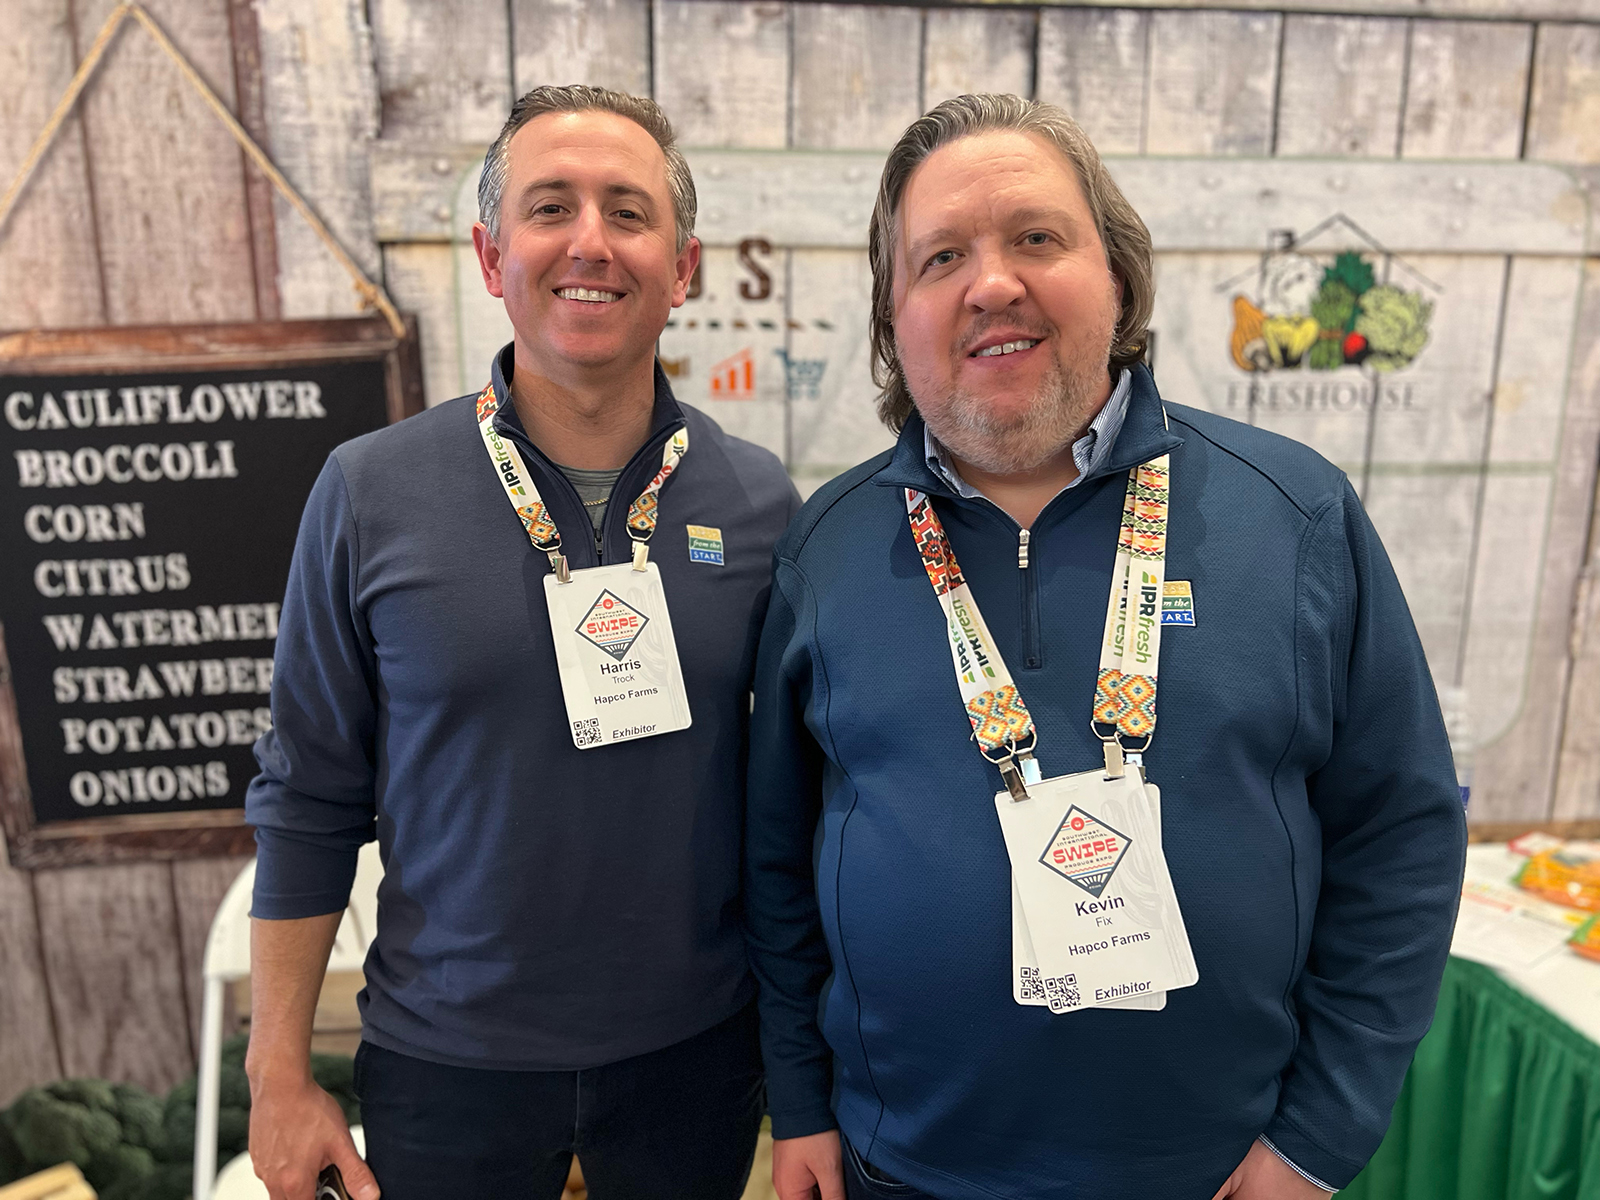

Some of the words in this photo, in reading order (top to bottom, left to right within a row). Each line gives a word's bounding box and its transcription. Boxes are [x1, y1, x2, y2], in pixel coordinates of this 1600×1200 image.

[4, 380, 326, 431] CAULIFLOWER
[14, 440, 238, 488] BROCCOLI
[486, 425, 521, 487] IPRfresh
[24, 502, 147, 543] CORN
[34, 553, 191, 598] CITRUS
[1174, 598, 1189, 607] the
[42, 602, 281, 651] WATERMEL
[586, 616, 639, 634] SWIPE
[1136, 585, 1157, 663] IPRfresh
[1161, 613, 1191, 621] TART
[53, 656, 275, 704] STRAWBER
[600, 659, 642, 675] Harris
[612, 674, 635, 684] Trock
[593, 692, 626, 705] Hapco
[628, 686, 659, 699] Farms
[60, 707, 273, 755] POTATOES
[612, 724, 657, 739] Exhibitor
[69, 761, 230, 807] ONIONS
[1053, 837, 1119, 864] SWIPE
[1074, 895, 1125, 917] Kevin
[1095, 916, 1113, 927] Fix
[1068, 940, 1109, 956] Hapco
[1111, 930, 1151, 948] Farms
[1095, 981, 1152, 1000] Exhibitor
